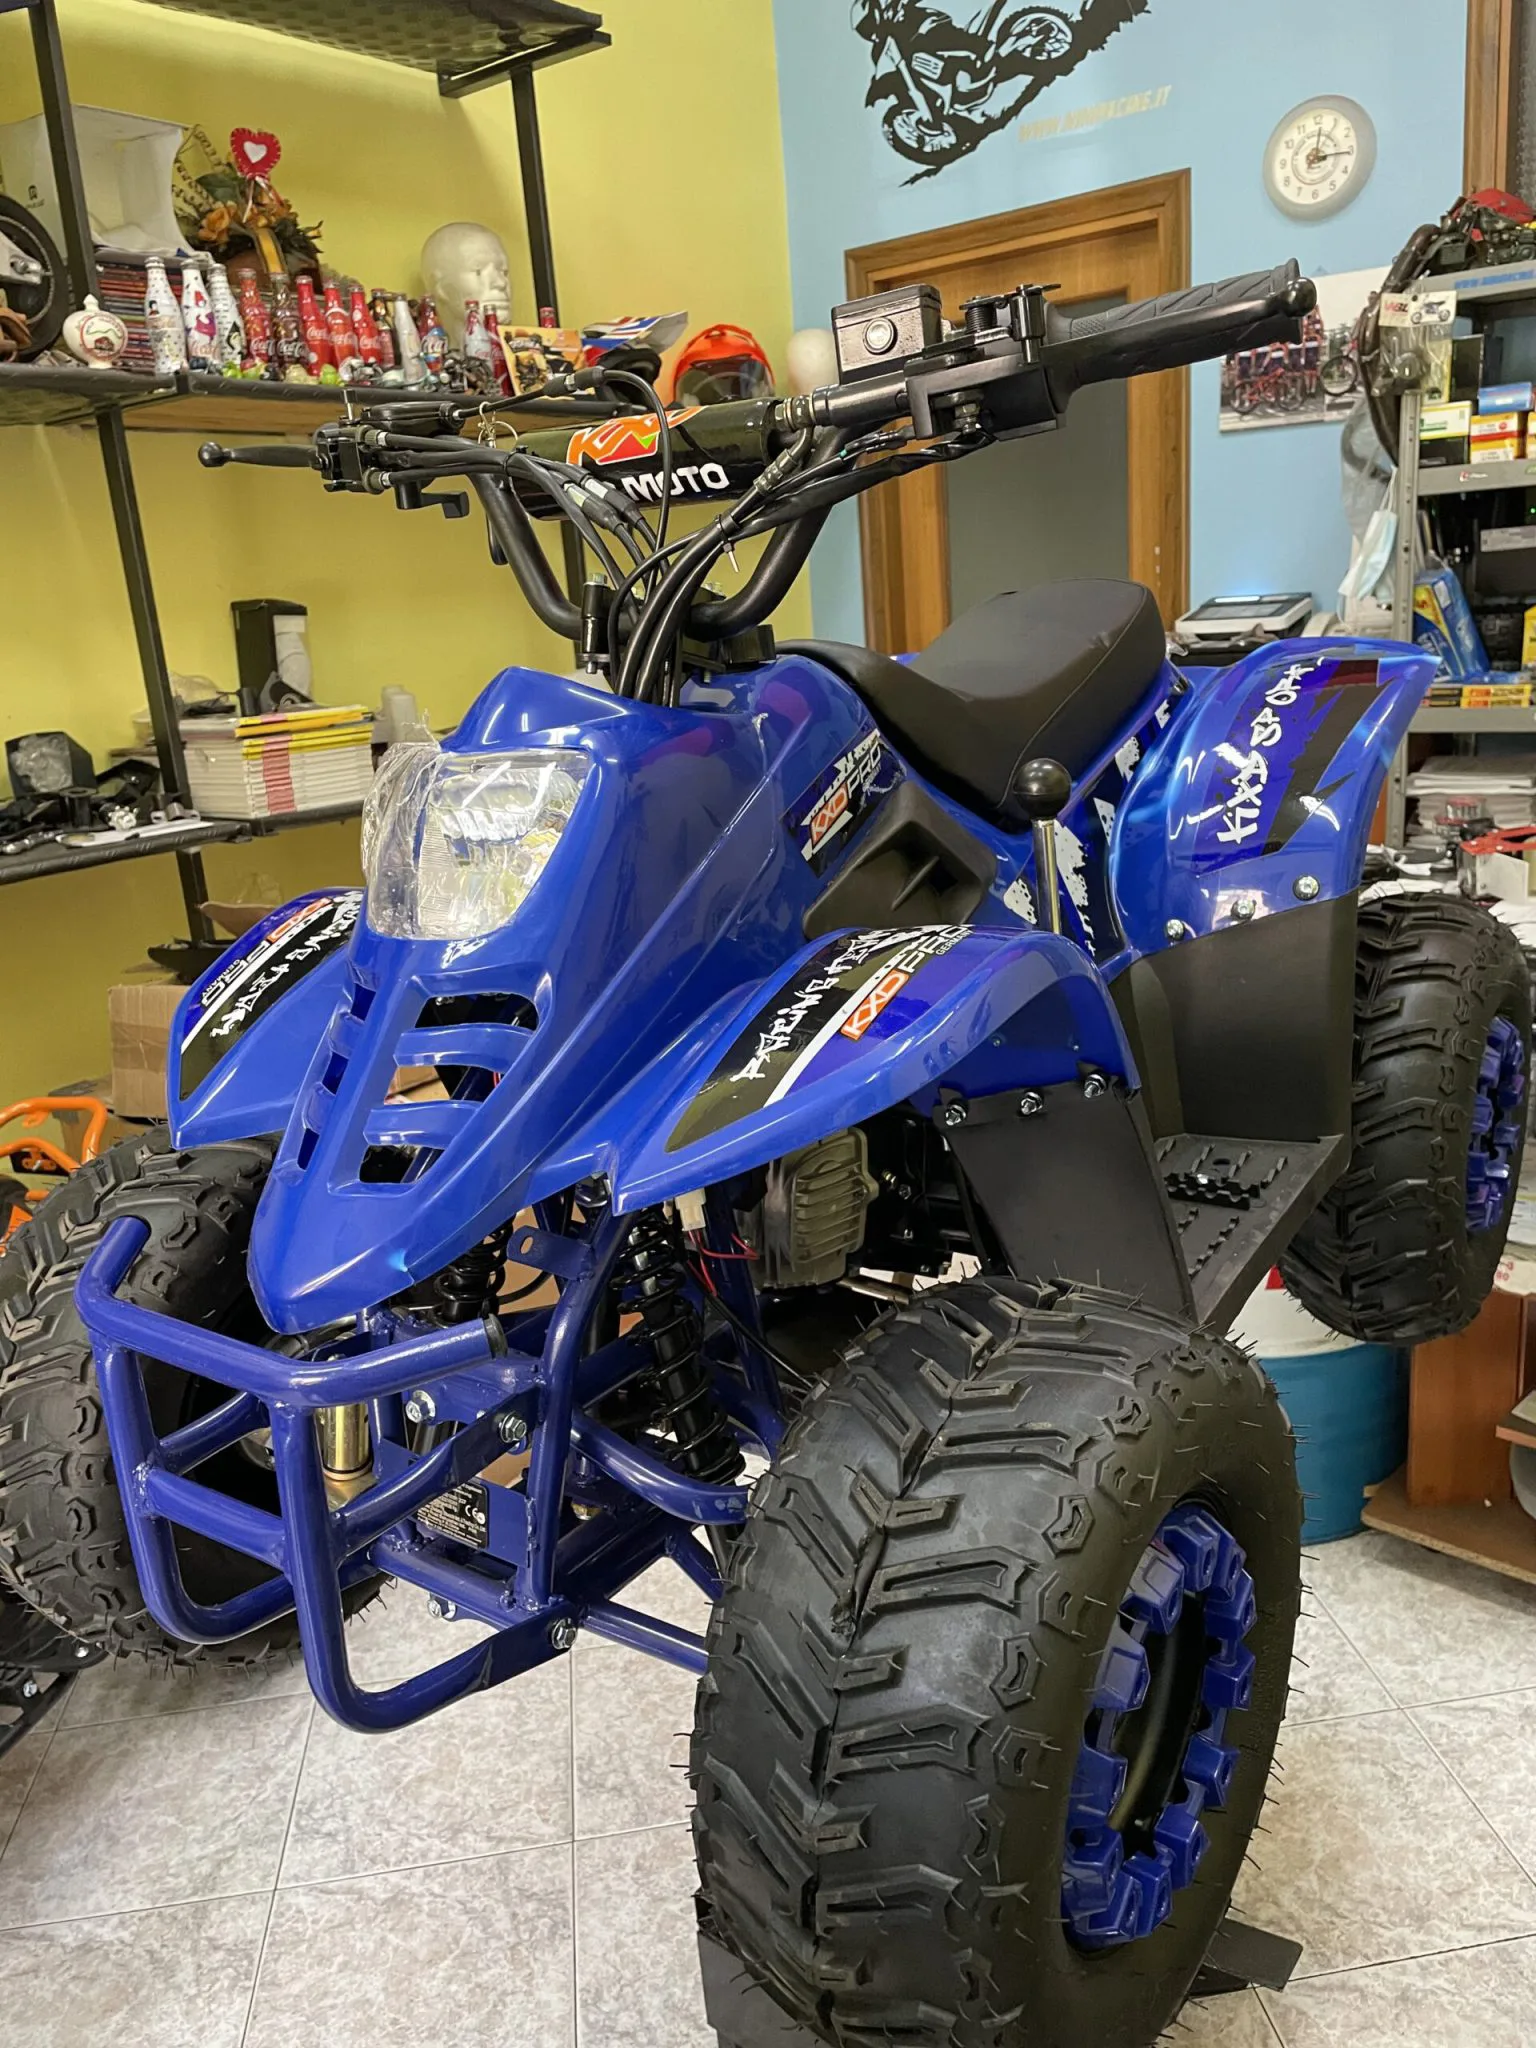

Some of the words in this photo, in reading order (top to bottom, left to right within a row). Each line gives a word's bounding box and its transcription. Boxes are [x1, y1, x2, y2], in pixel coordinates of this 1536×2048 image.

[1313, 114, 1323, 125] 12
[1343, 127, 1352, 138] 2
[1280, 159, 1287, 169] 9
[1312, 189, 1319, 200] 6
[1329, 180, 1336, 190] 5
[621, 462, 730, 502] MOTO
[810, 786, 849, 843] KXD
[200, 940, 271, 1008] PRO
[202, 958, 241, 998] GERMANY
[843, 973, 907, 1036] KXD
[898, 925, 968, 974] PRO
